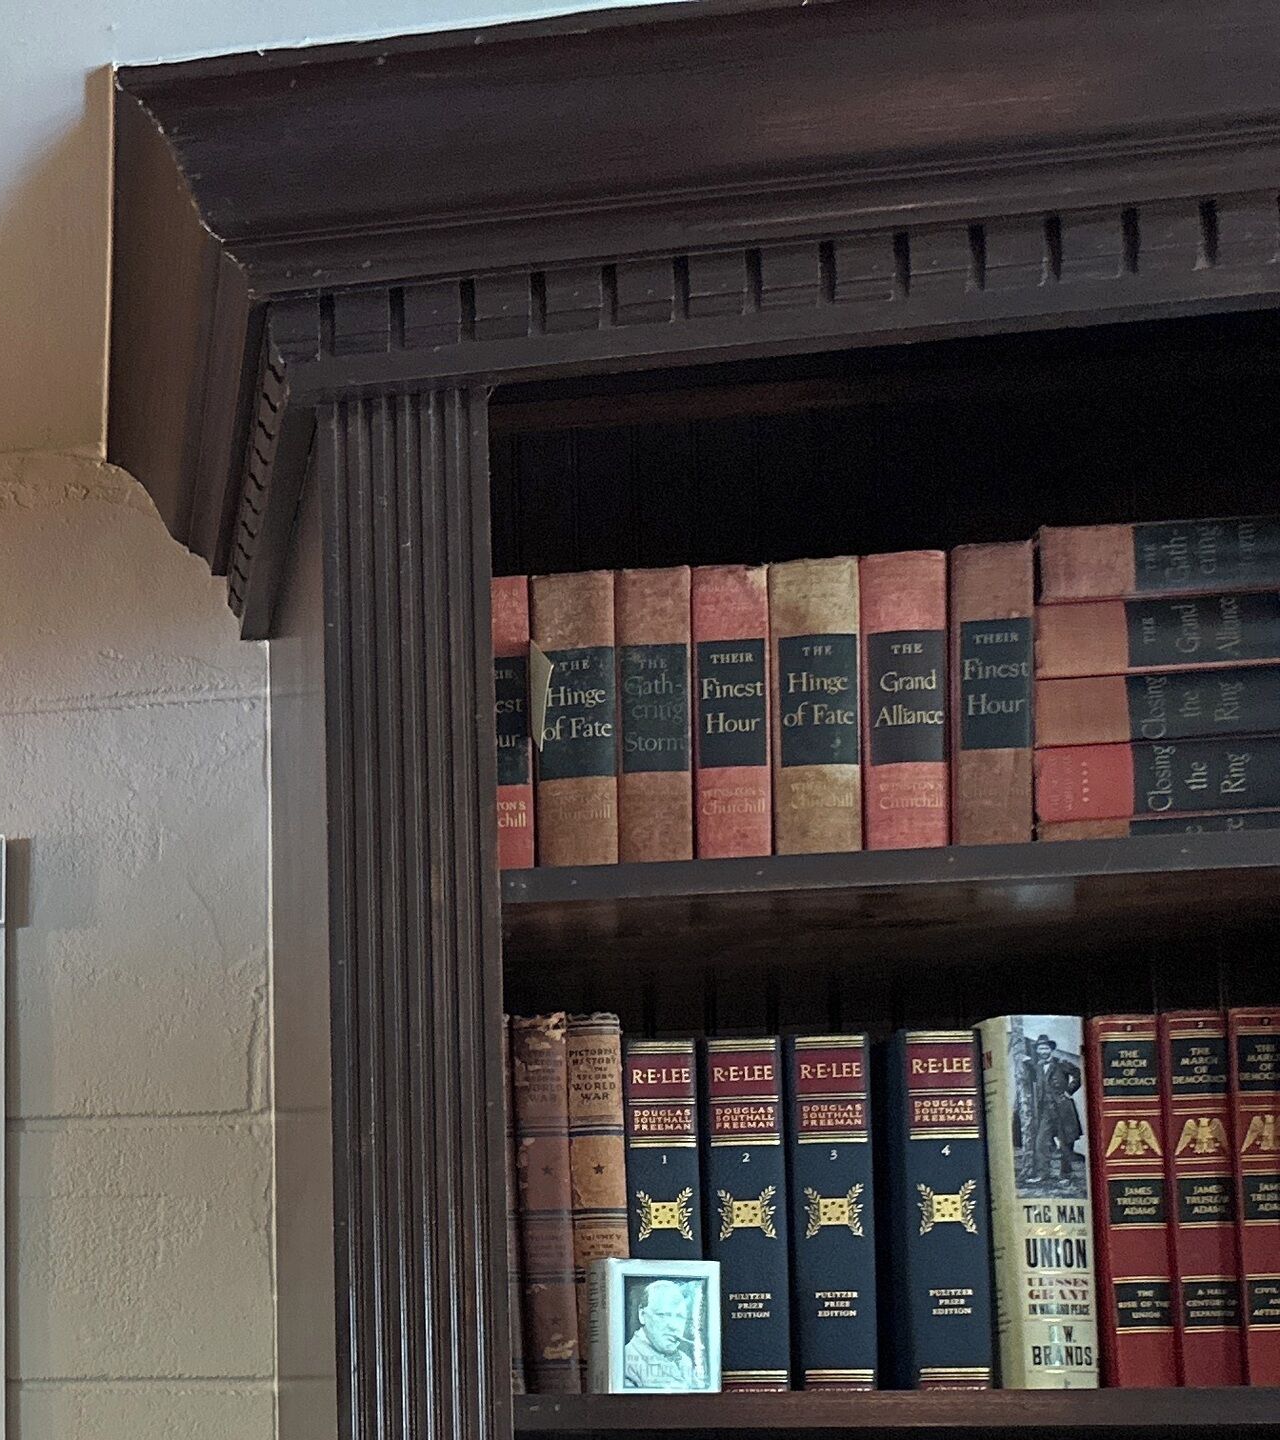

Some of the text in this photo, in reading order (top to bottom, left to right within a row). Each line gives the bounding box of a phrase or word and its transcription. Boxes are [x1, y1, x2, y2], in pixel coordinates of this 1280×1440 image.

[1170, 604, 1200, 655] Grand
[974, 632, 1020, 645] THEIR
[802, 645, 833, 657] THE
[891, 643, 924, 655] THE
[710, 653, 754, 665] THEIR
[560, 659, 590, 671] THE
[963, 658, 1030, 682] Finest
[787, 672, 849, 695] Hinge
[879, 669, 938, 694] Grand
[701, 677, 764, 700] Finest
[546, 686, 607, 708] Hinge
[1214, 680, 1244, 723] Ring
[966, 694, 1026, 717] Hour
[1141, 674, 1168, 740] Closing
[1179, 690, 1201, 719] the
[783, 702, 855, 728] of Fate
[874, 706, 945, 729] Alliance
[705, 712, 761, 735] Hour
[542, 717, 613, 741] of Fate
[1148, 743, 1177, 812] Closing
[1184, 761, 1209, 791] the
[1220, 751, 1252, 795] Ring
[1118, 1050, 1138, 1058] THE
[1111, 1060, 1147, 1068] MARCH
[1122, 1069, 1136, 1077] OF
[1194, 1066, 1208, 1074] OF
[572, 1081, 616, 1091] WORLD
[1103, 1077, 1157, 1087] DEMOCRACY
[580, 1091, 610, 1101] WAR
[802, 1104, 863, 1112] DOUGLAS
[914, 1099, 974, 1108] DOUGLAS
[634, 1109, 691, 1117] DOUGLAS
[715, 1106, 774, 1115] DOUGLAS
[802, 1111, 863, 1120] SOUTHALL
[914, 1107, 975, 1115] SOUTHALL
[634, 1116, 692, 1124] SOUTHALL
[715, 1114, 775, 1122] SOUTHALL
[803, 1119, 863, 1127] FREEMAN
[914, 1114, 974, 1122] FREEMAN
[634, 1123, 691, 1132] FREEMAN
[715, 1121, 775, 1130] FREEMAN
[941, 1144, 951, 1156] 4
[661, 1155, 668, 1165] 1
[742, 1153, 750, 1163] 2
[829, 1150, 838, 1161] 3
[1124, 1187, 1153, 1195] JAMES
[1023, 1205, 1085, 1223] THE MAN
[1123, 1206, 1156, 1215] ADAMS
[1025, 1238, 1087, 1268] UNION
[929, 1288, 973, 1297] PULITZER
[824, 1300, 850, 1308] PRIZE
[939, 1298, 965, 1306] PRIZE
[931, 1307, 972, 1316] EDITION
[1032, 1346, 1093, 1366] BRANDS
